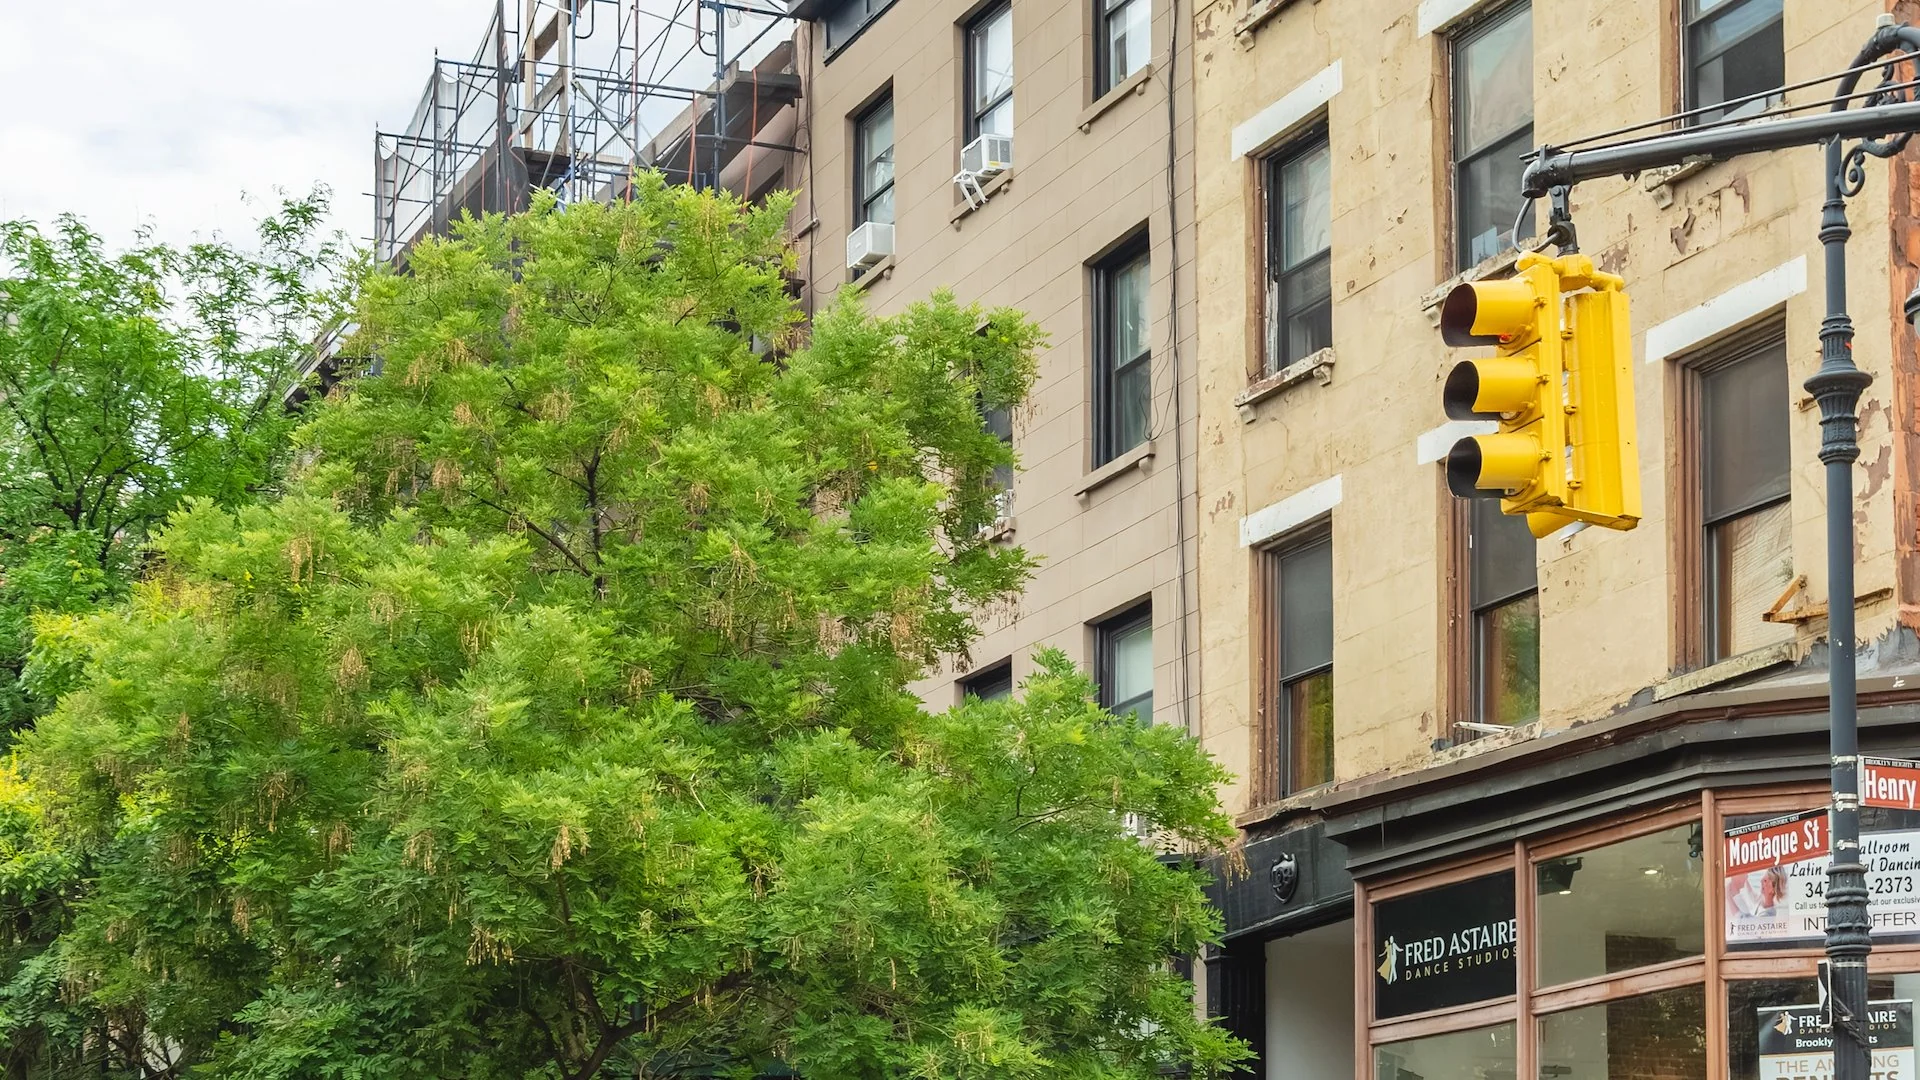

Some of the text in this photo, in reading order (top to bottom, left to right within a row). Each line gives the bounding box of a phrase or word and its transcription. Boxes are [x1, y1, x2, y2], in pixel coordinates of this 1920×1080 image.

[1865, 769, 1916, 809] Henry
[1729, 819, 1820, 867] Montague St
[1859, 840, 1910, 855] allroom
[1790, 862, 1822, 877] Latin
[1879, 856, 1920, 872] Dancin
[1795, 902, 1808, 910] Call
[1893, 896, 1920, 905] exclusiv
[1737, 922, 1788, 932] FRED ASTAIRE
[1804, 916, 1828, 931] INT
[1404, 918, 1517, 966] FRED ASTAIRE
[1405, 946, 1517, 981] DANCE STUDIOS
[1799, 1015, 1822, 1027] FRE
[1800, 1027, 1831, 1035] DANC
[1795, 1037, 1834, 1048] Brookly
[1776, 1060, 1809, 1074] THE
